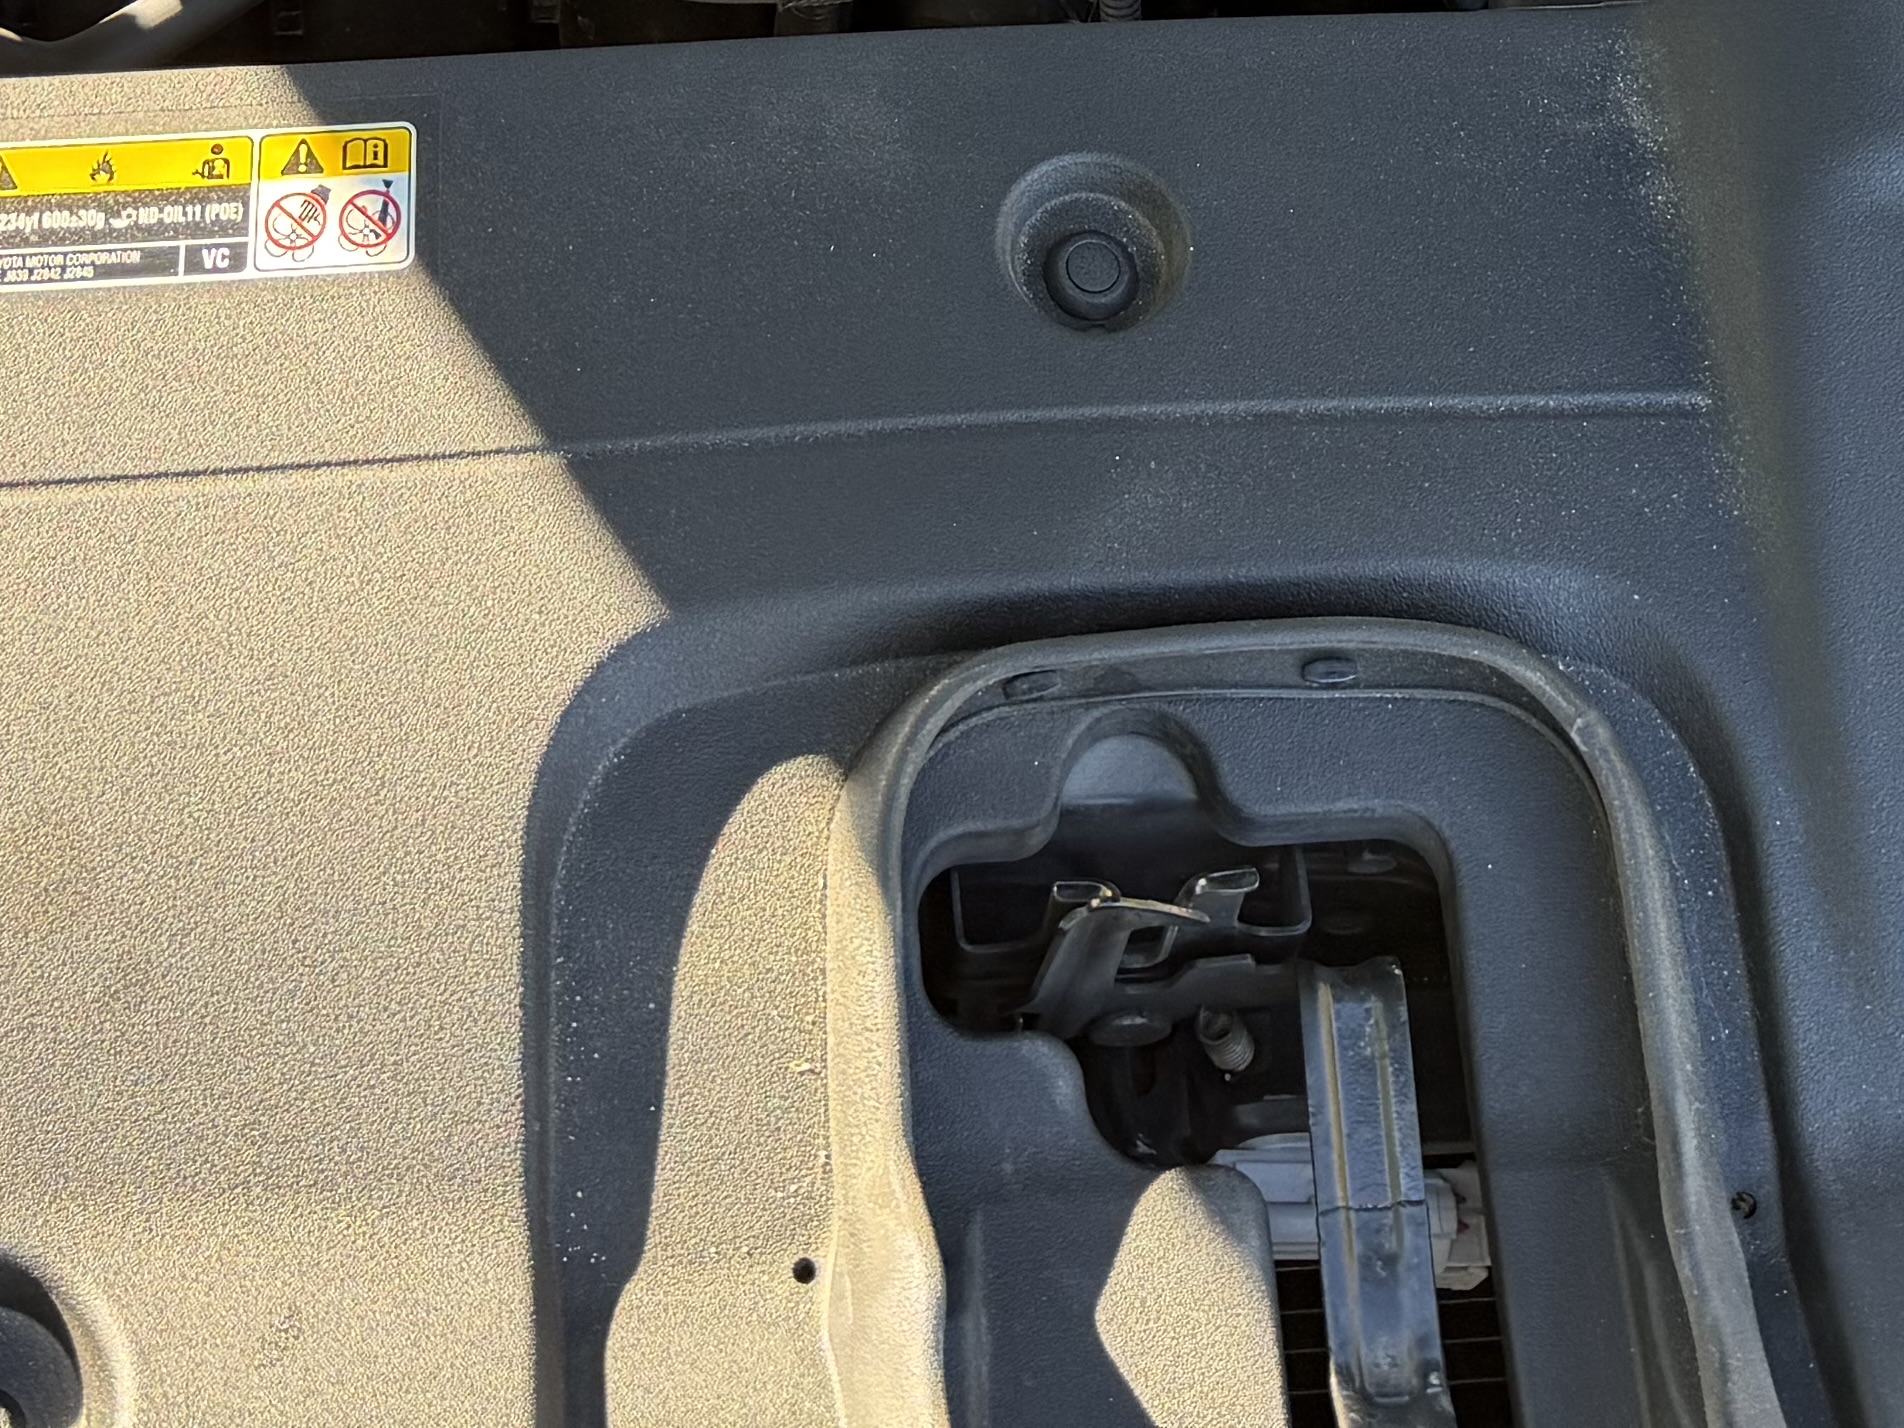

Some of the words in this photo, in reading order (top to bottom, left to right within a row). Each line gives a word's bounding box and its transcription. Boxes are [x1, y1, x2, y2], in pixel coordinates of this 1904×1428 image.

[205, 201, 244, 223] (POE)
[25, 253, 65, 269] MOTOR
[65, 250, 141, 267] CORPORATION
[202, 247, 230, 269] VC
